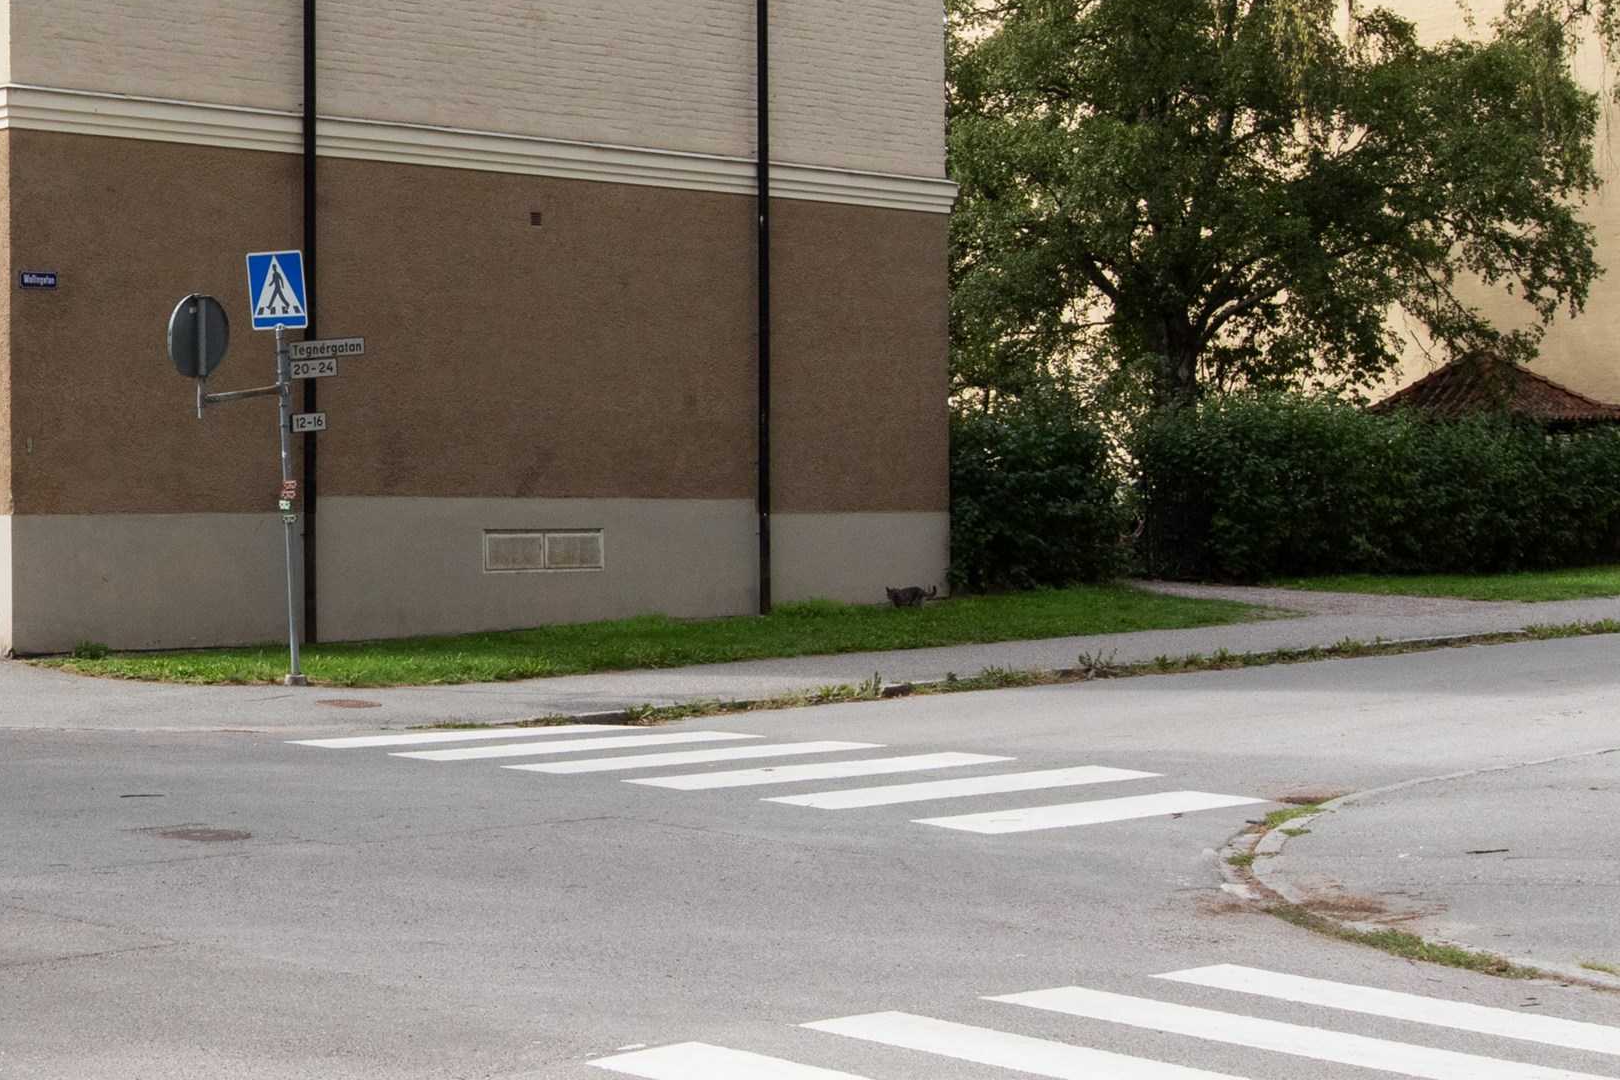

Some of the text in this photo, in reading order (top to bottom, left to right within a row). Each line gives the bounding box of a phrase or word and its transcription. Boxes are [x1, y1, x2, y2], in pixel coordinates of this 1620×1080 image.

[292, 342, 362, 357] Tegnérgatan
[293, 361, 334, 375] 20-24
[295, 415, 323, 428] 12-16
